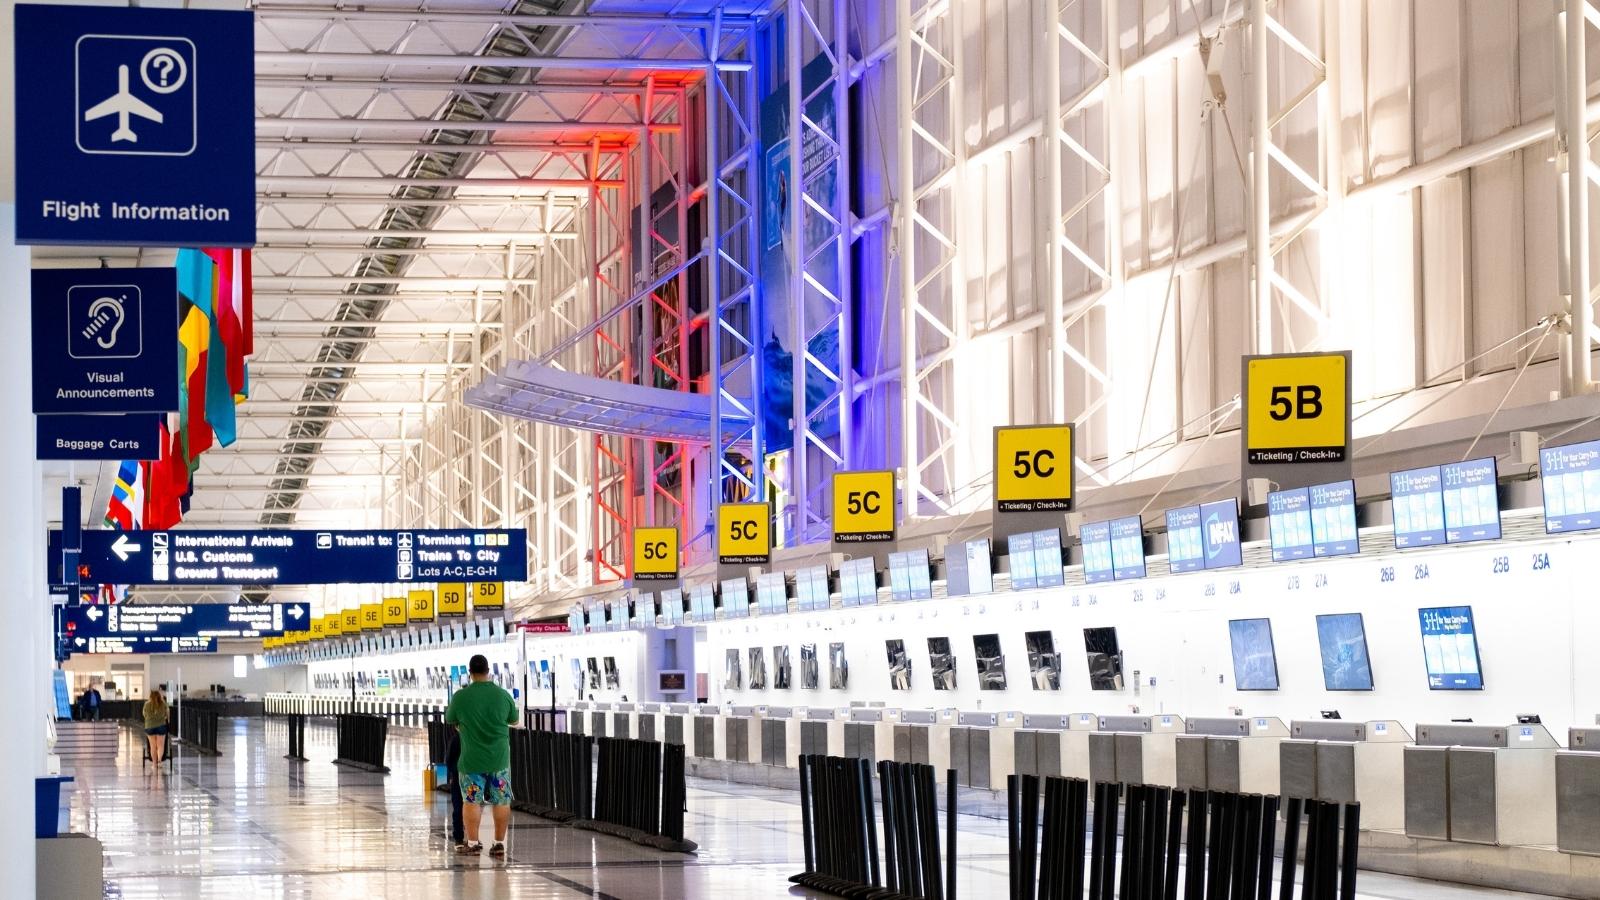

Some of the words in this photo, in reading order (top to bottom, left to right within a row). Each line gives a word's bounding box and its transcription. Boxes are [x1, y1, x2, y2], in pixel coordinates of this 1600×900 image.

[43, 200, 100, 221] Flight
[112, 202, 230, 221] Information
[87, 372, 124, 382] Visual
[56, 388, 154, 398] Announcements
[1269, 385, 1322, 421] 5B
[56, 439, 104, 450] Baggage
[110, 440, 139, 449] Carts
[1256, 451, 1293, 462] Ticketing
[1300, 450, 1336, 460] Check-In
[1545, 450, 1564, 472] 3-1-1
[1013, 450, 1055, 478] 5C
[1445, 466, 1461, 486] 3-1-1
[848, 490, 880, 514] 5C
[1005, 502, 1032, 512] Ticketing
[1036, 500, 1064, 510] Check-In
[730, 520, 758, 540] 5C
[1210, 521, 1235, 544] INFAX
[175, 535, 246, 547] International
[251, 536, 293, 547] Arrivals
[336, 535, 374, 546] Transit
[378, 535, 392, 546] to:
[418, 534, 471, 546] Terminals
[418, 550, 452, 561] Trains
[457, 550, 471, 561] To
[477, 550, 499, 562] City
[644, 542, 668, 560] 5C
[175, 552, 198, 563] U.S.
[202, 552, 253, 563] Customs
[1533, 553, 1550, 570] 25A
[1493, 557, 1509, 573] 25B
[175, 567, 218, 579] Ground
[222, 567, 278, 580] Transport
[418, 566, 440, 576] Lots
[443, 566, 497, 577] A-C,E-G-H
[1380, 567, 1394, 582] 26B
[1414, 564, 1429, 580] 26A
[1288, 576, 1300, 590] 27B
[1315, 574, 1328, 587] 27A
[480, 584, 496, 596] 5D
[444, 592, 459, 604] 5D
[414, 600, 428, 610] 5D
[366, 612, 377, 621] 5E
[388, 606, 401, 617] 5D
[329, 620, 339, 629] 5E
[346, 616, 357, 625] 5E
[1424, 612, 1440, 631] 3-1-1
[314, 624, 322, 633] 5E
